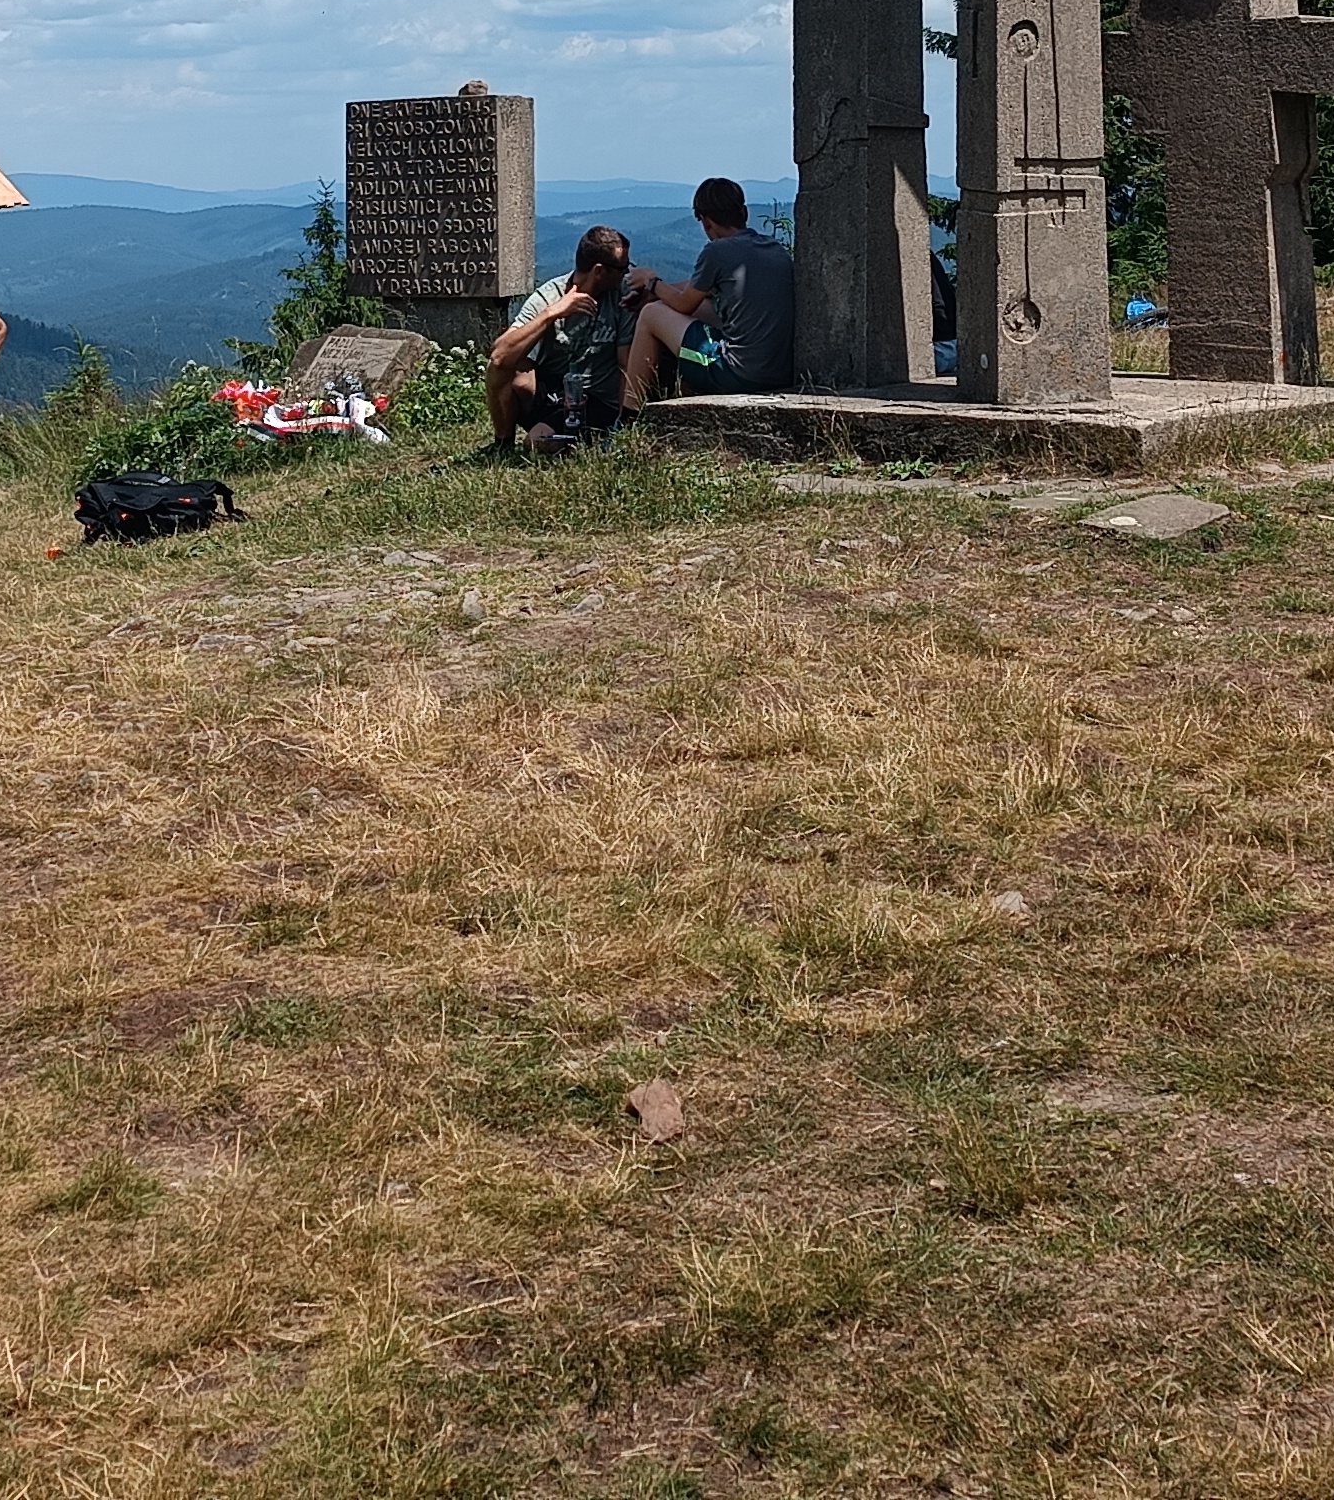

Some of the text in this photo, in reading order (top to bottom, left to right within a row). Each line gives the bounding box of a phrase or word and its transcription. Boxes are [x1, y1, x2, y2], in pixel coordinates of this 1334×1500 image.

[350, 103, 381, 118] DNE
[418, 136, 496, 155] KARLOVIC
[381, 160, 402, 176] NA
[347, 180, 386, 196] PADLI
[389, 179, 420, 195] DVA
[443, 217, 497, 234] SBORU
[348, 239, 357, 254] A
[375, 278, 386, 293] V
